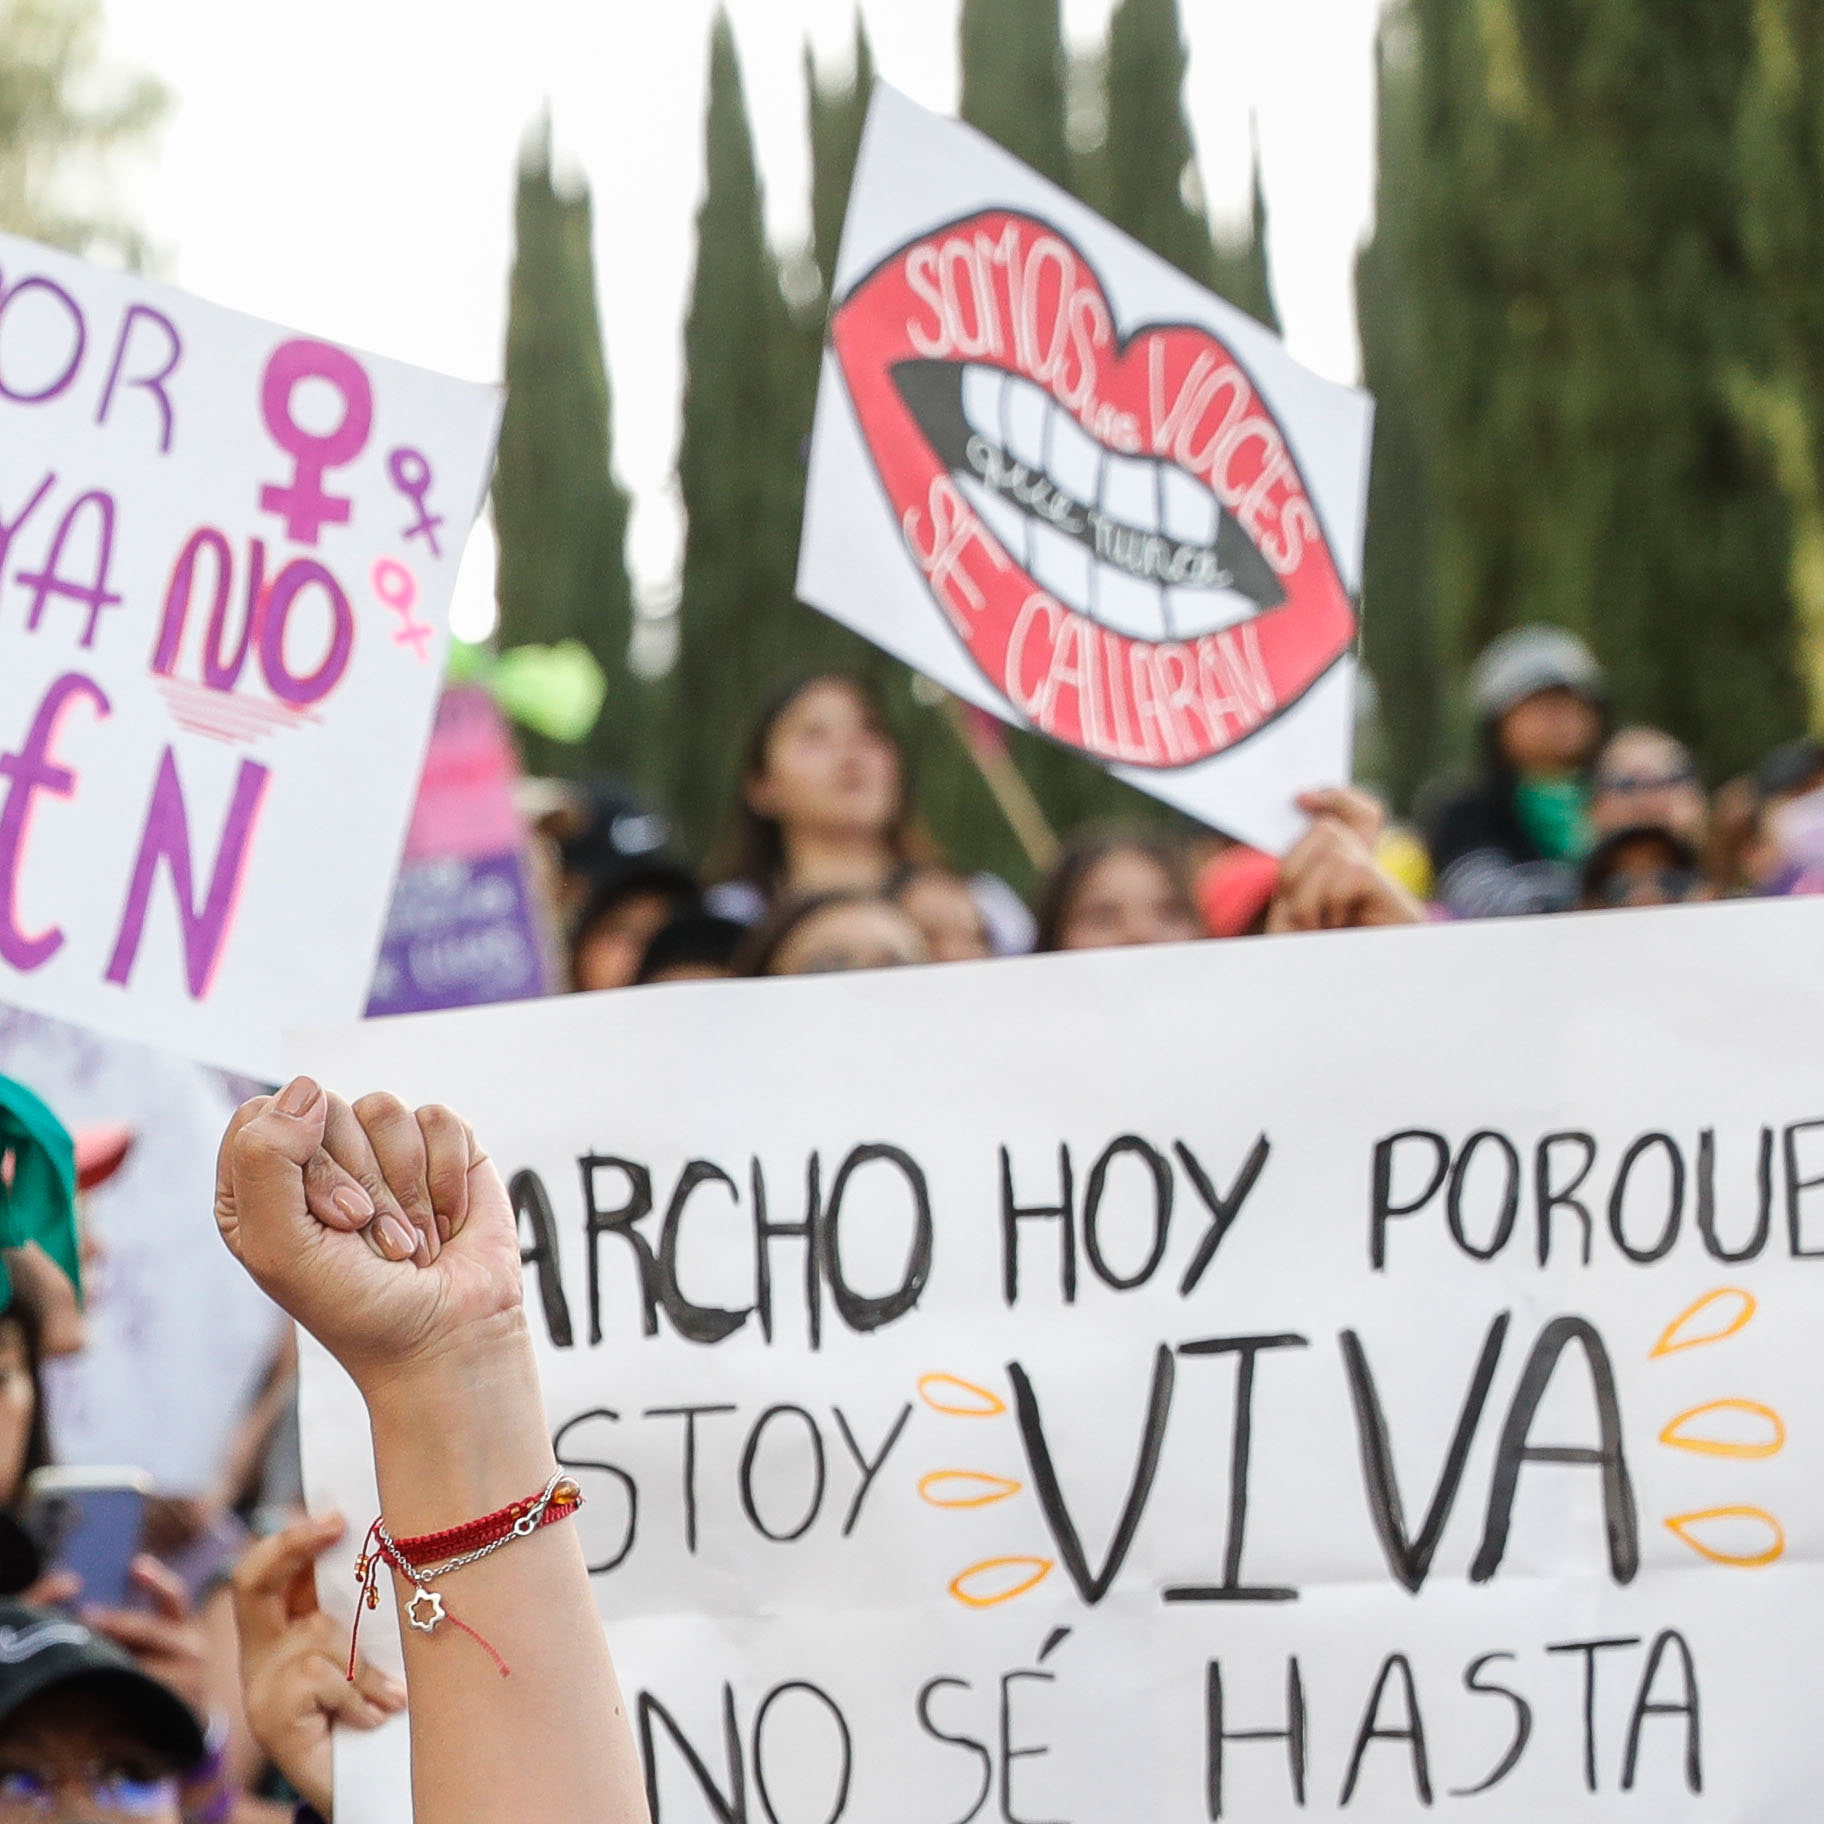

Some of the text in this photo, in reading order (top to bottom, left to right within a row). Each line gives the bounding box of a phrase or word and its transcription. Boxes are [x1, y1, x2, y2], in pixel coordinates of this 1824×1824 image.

[905, 221, 1109, 410] SOMOS
[1148, 334, 1320, 574] VOCES
[150, 524, 356, 711] NO
[507, 1142, 935, 1351] ARCHO
[999, 1132, 1272, 1308] HOY
[555, 1310, 1640, 1606] STOY VIVA
[1205, 1629, 1704, 1824] HASTA
